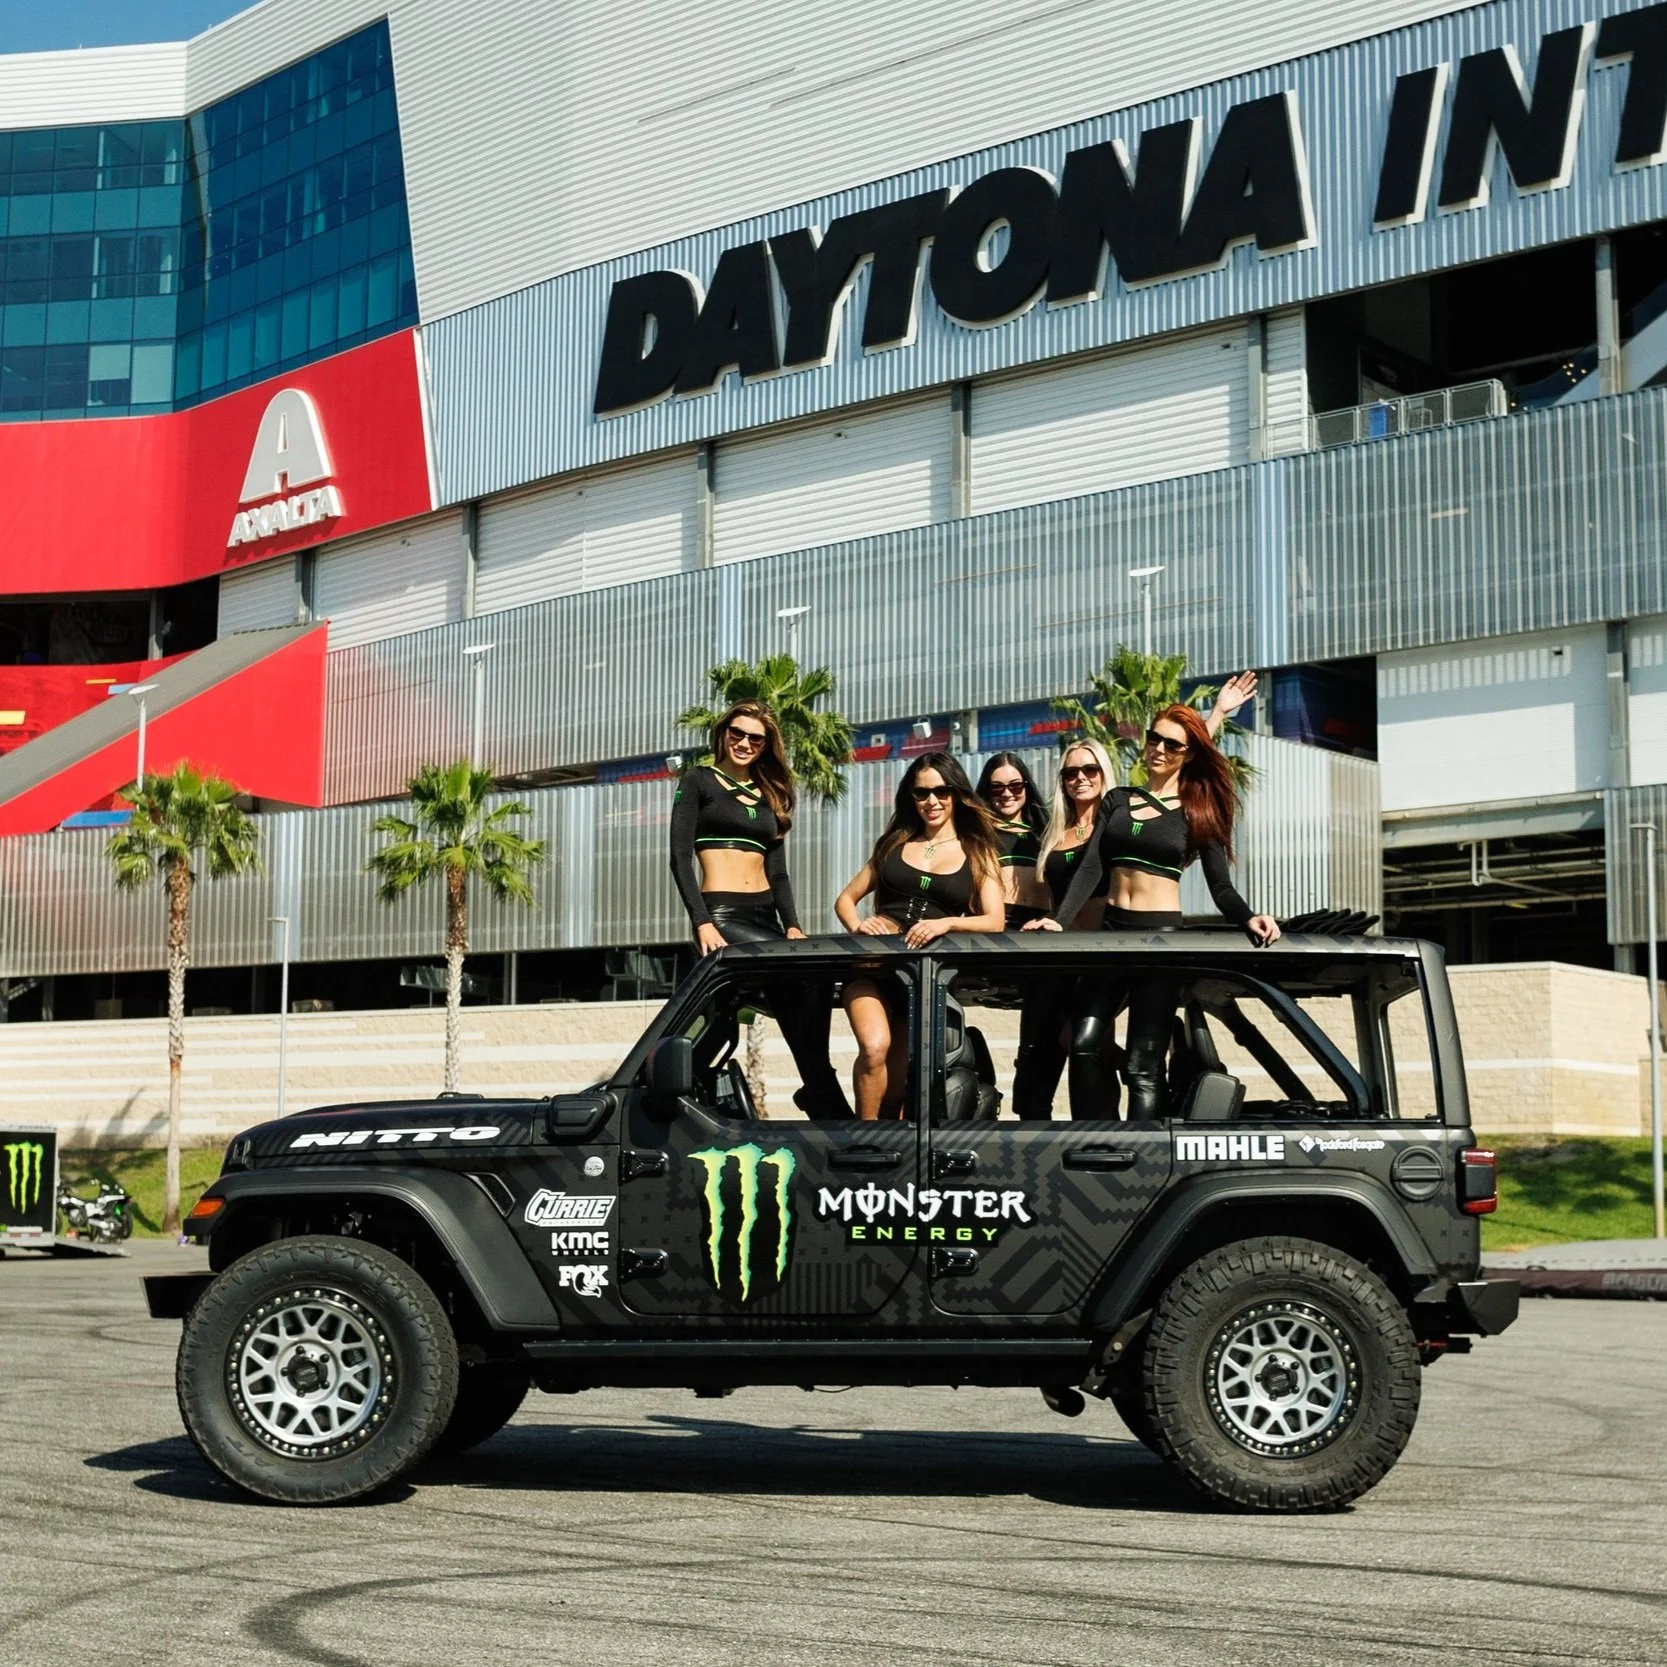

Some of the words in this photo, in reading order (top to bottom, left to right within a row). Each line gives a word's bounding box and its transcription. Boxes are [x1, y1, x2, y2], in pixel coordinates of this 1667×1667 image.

[594, 88, 1317, 422] DAYTONA
[227, 485, 343, 547] AXALTA
[289, 1126, 501, 1148] NITTO
[1176, 1136, 1285, 1161] MAHLE
[528, 1190, 611, 1222] CURRIE
[818, 1182, 1031, 1224] MONSTER
[551, 1231, 609, 1250] KMC
[851, 1226, 998, 1241] ENERGY
[558, 1264, 609, 1298] FOX
